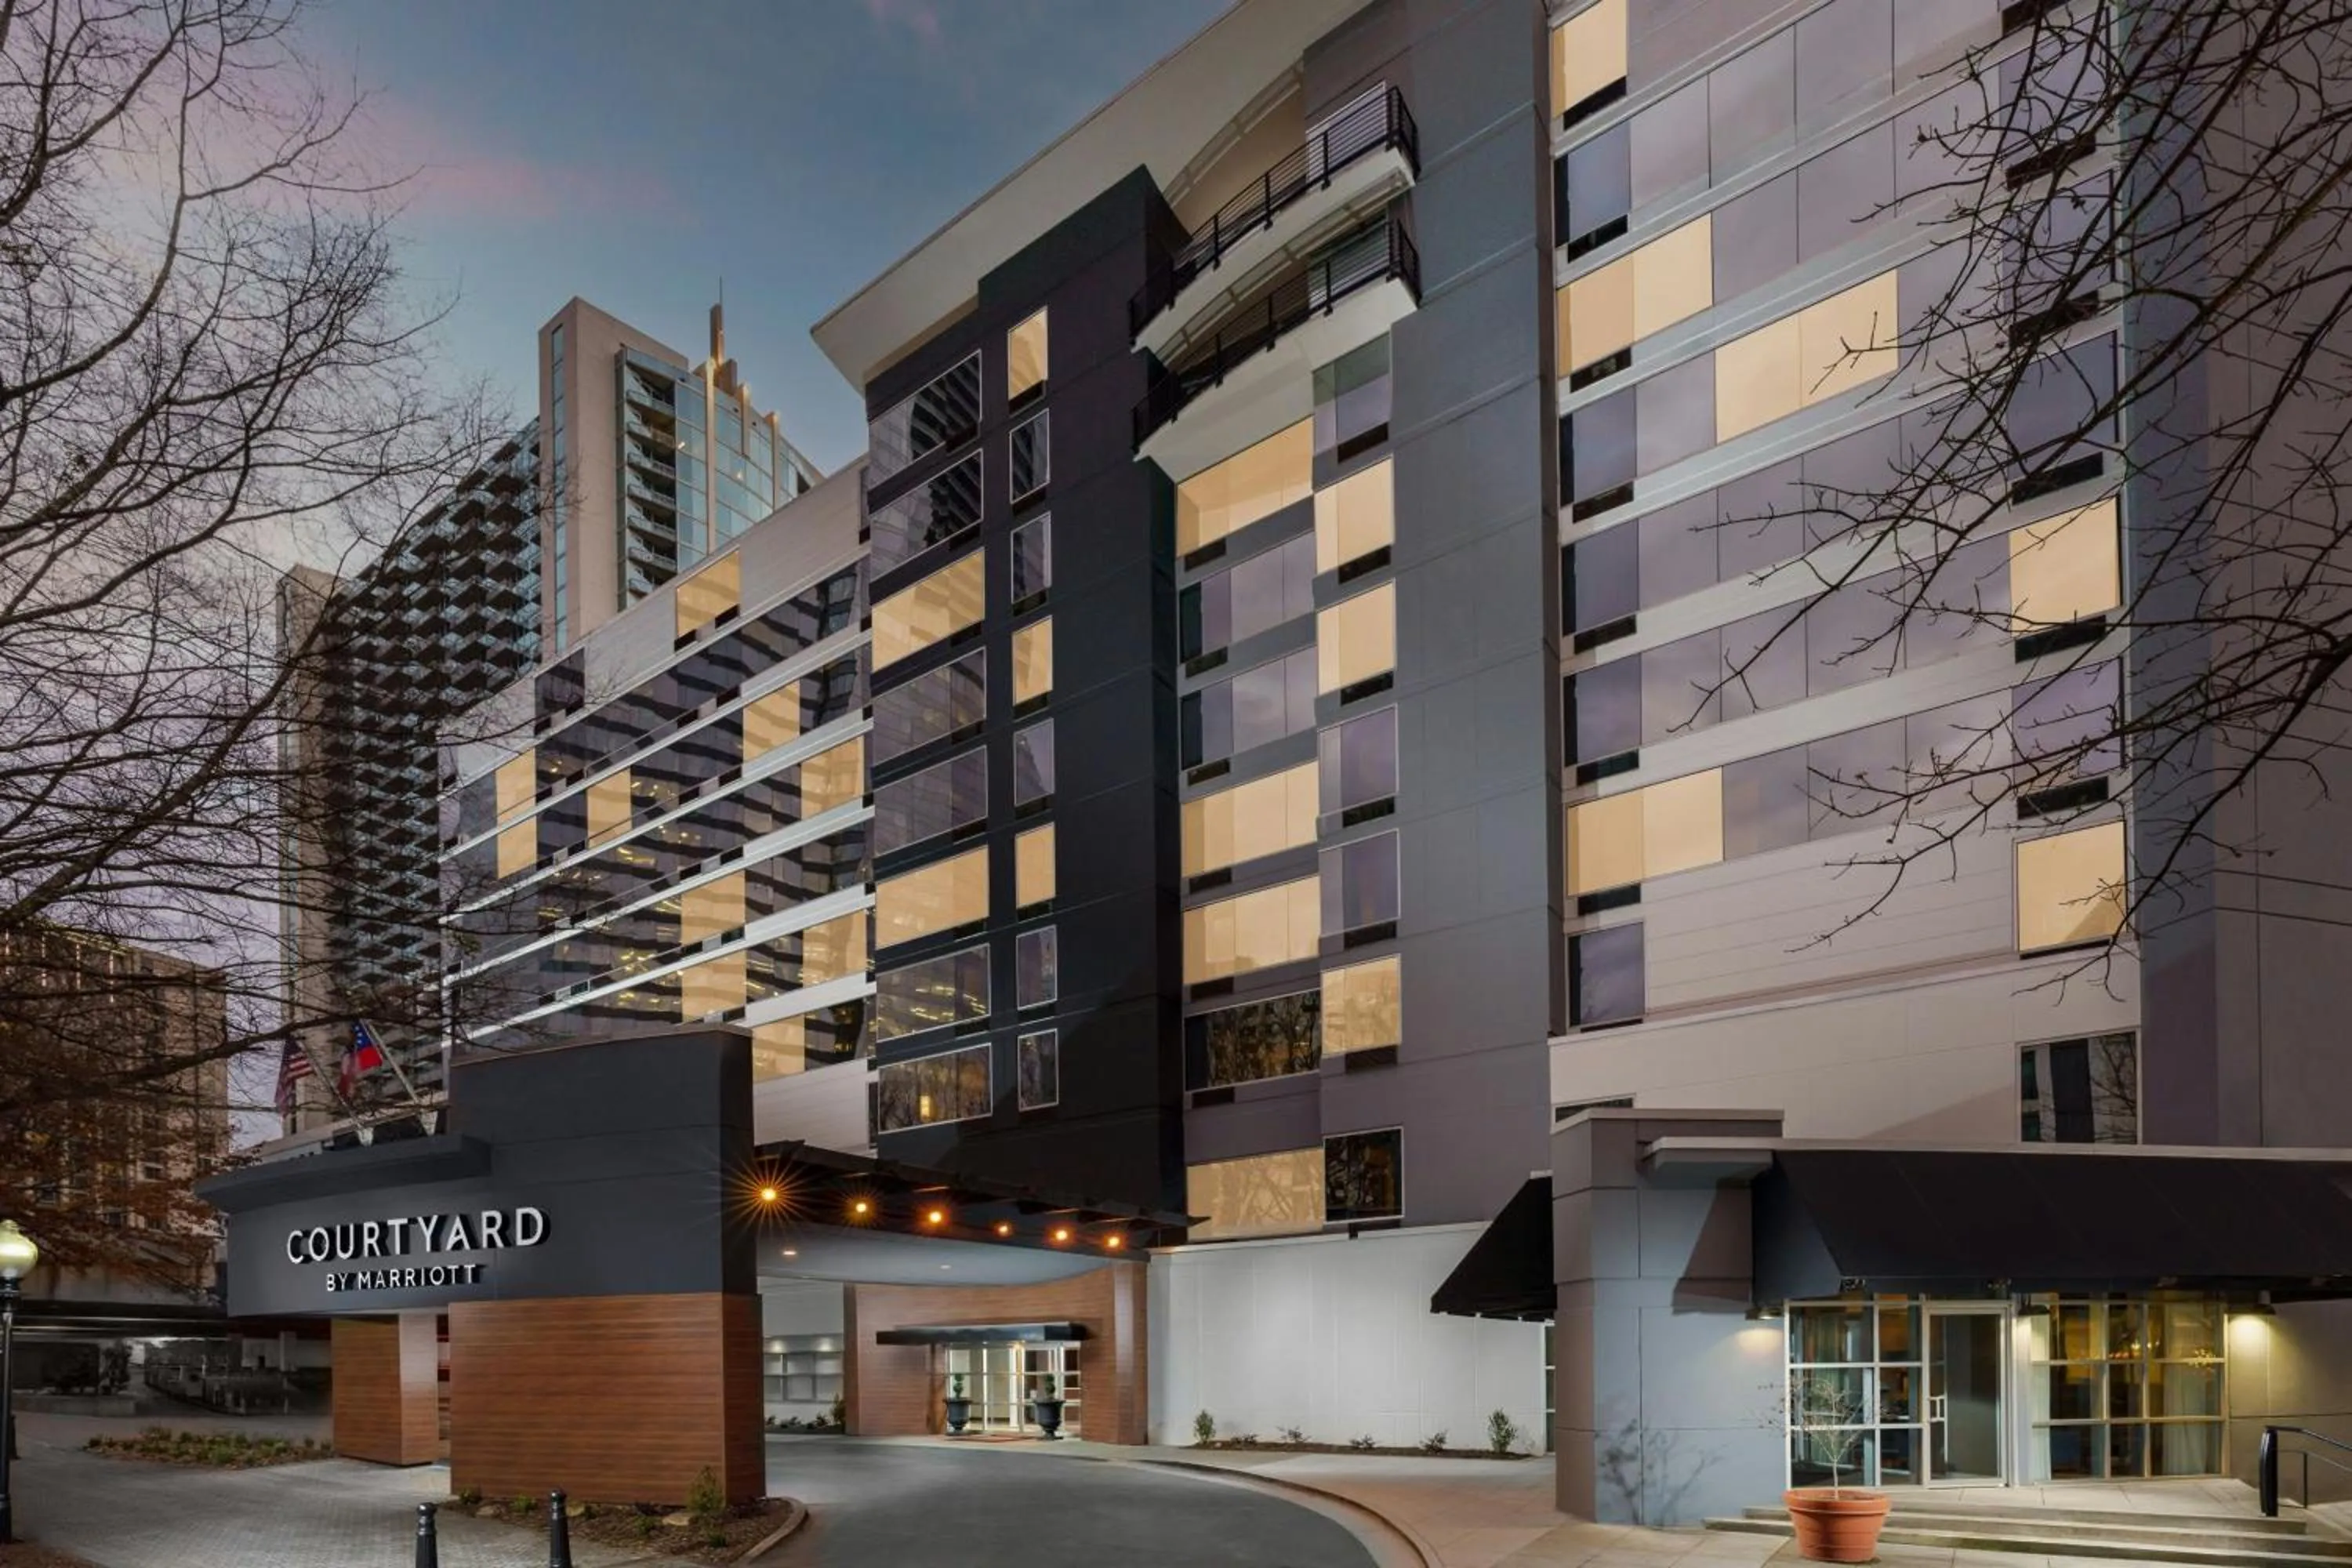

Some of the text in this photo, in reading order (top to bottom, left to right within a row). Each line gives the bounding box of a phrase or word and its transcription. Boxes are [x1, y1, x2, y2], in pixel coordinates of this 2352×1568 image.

[286, 1207, 546, 1265] COURTYARD
[325, 1264, 477, 1292] BY MARRIOTT
